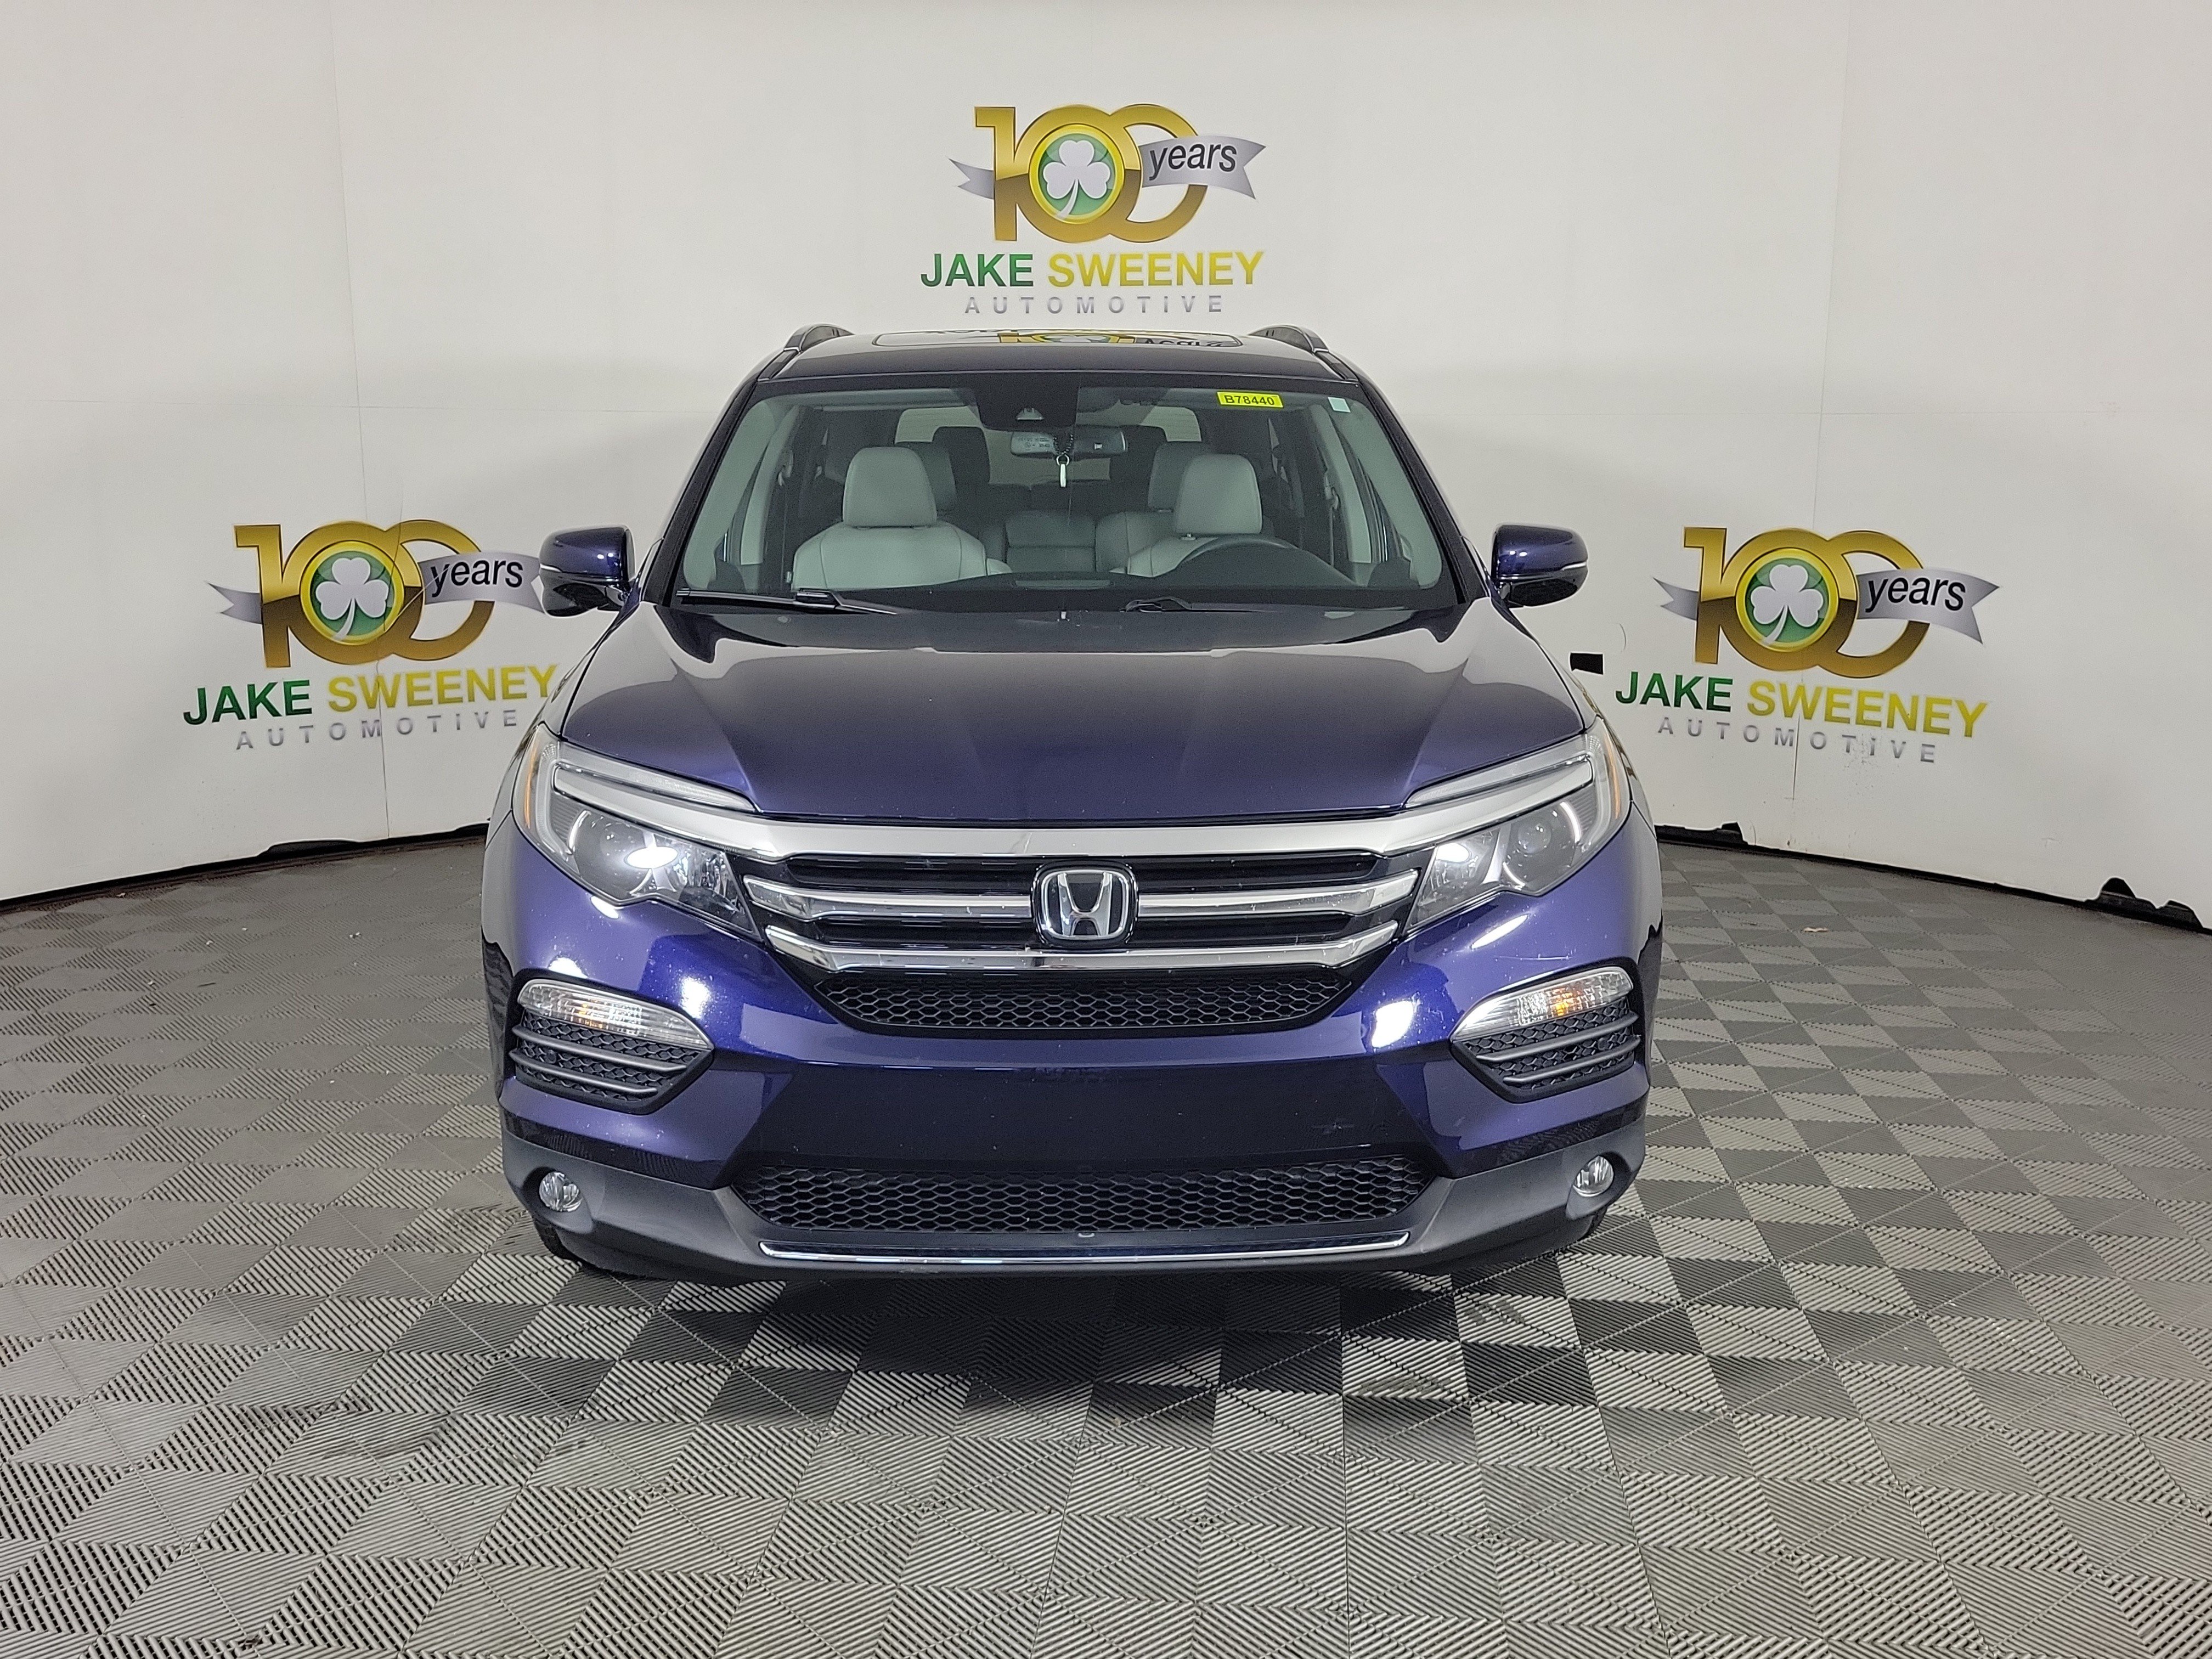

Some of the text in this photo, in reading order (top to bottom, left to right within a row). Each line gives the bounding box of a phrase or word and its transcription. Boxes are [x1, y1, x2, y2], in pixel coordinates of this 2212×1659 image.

[974, 104, 1209, 243] 100
[1149, 142, 1238, 180] years
[920, 250, 1265, 287] JAKE SWEENEY
[964, 295, 1222, 314] AUTOMOTIVE
[1223, 395, 1275, 405] B78440
[233, 520, 495, 669] 100
[431, 556, 524, 595] years
[1865, 576, 1966, 612] years
[1683, 527, 1930, 679] 100
[183, 664, 558, 725] JAKE SWEENEY
[1615, 670, 1988, 738] JAKE SWEENEY
[236, 709, 517, 751] AUTOMOTIVE
[1658, 716, 1937, 764] AUTOMOTIVE
